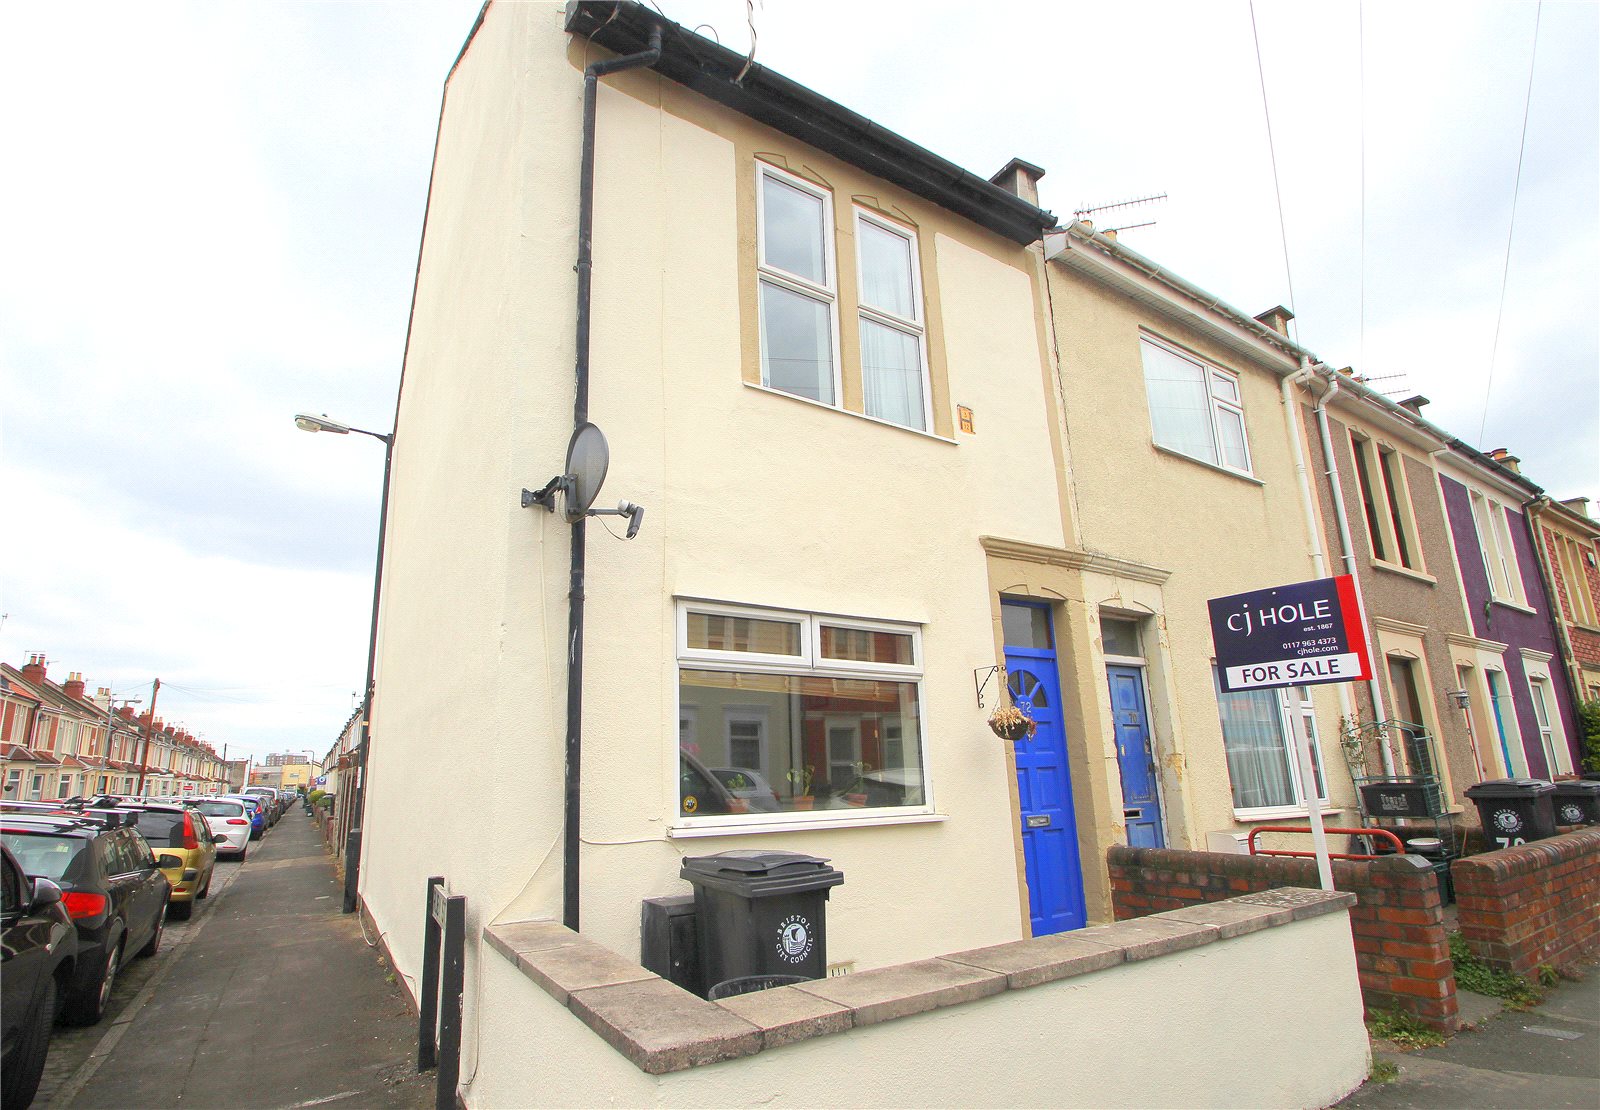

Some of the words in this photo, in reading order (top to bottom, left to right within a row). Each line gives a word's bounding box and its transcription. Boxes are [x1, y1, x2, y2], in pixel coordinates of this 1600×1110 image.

[1259, 600, 1331, 626] HOLE
[1282, 641, 1300, 650] 0117
[1302, 639, 1316, 647] 963
[1317, 637, 1337, 645] 4373
[1297, 645, 1338, 656] cjhole.com
[1242, 665, 1280, 683] FOR
[1286, 658, 1341, 679] SALE
[1020, 701, 1032, 713] 72
[777, 915, 810, 934] BRISTOL
[776, 943, 789, 962] CITY
[790, 937, 814, 964] COUNCIL
